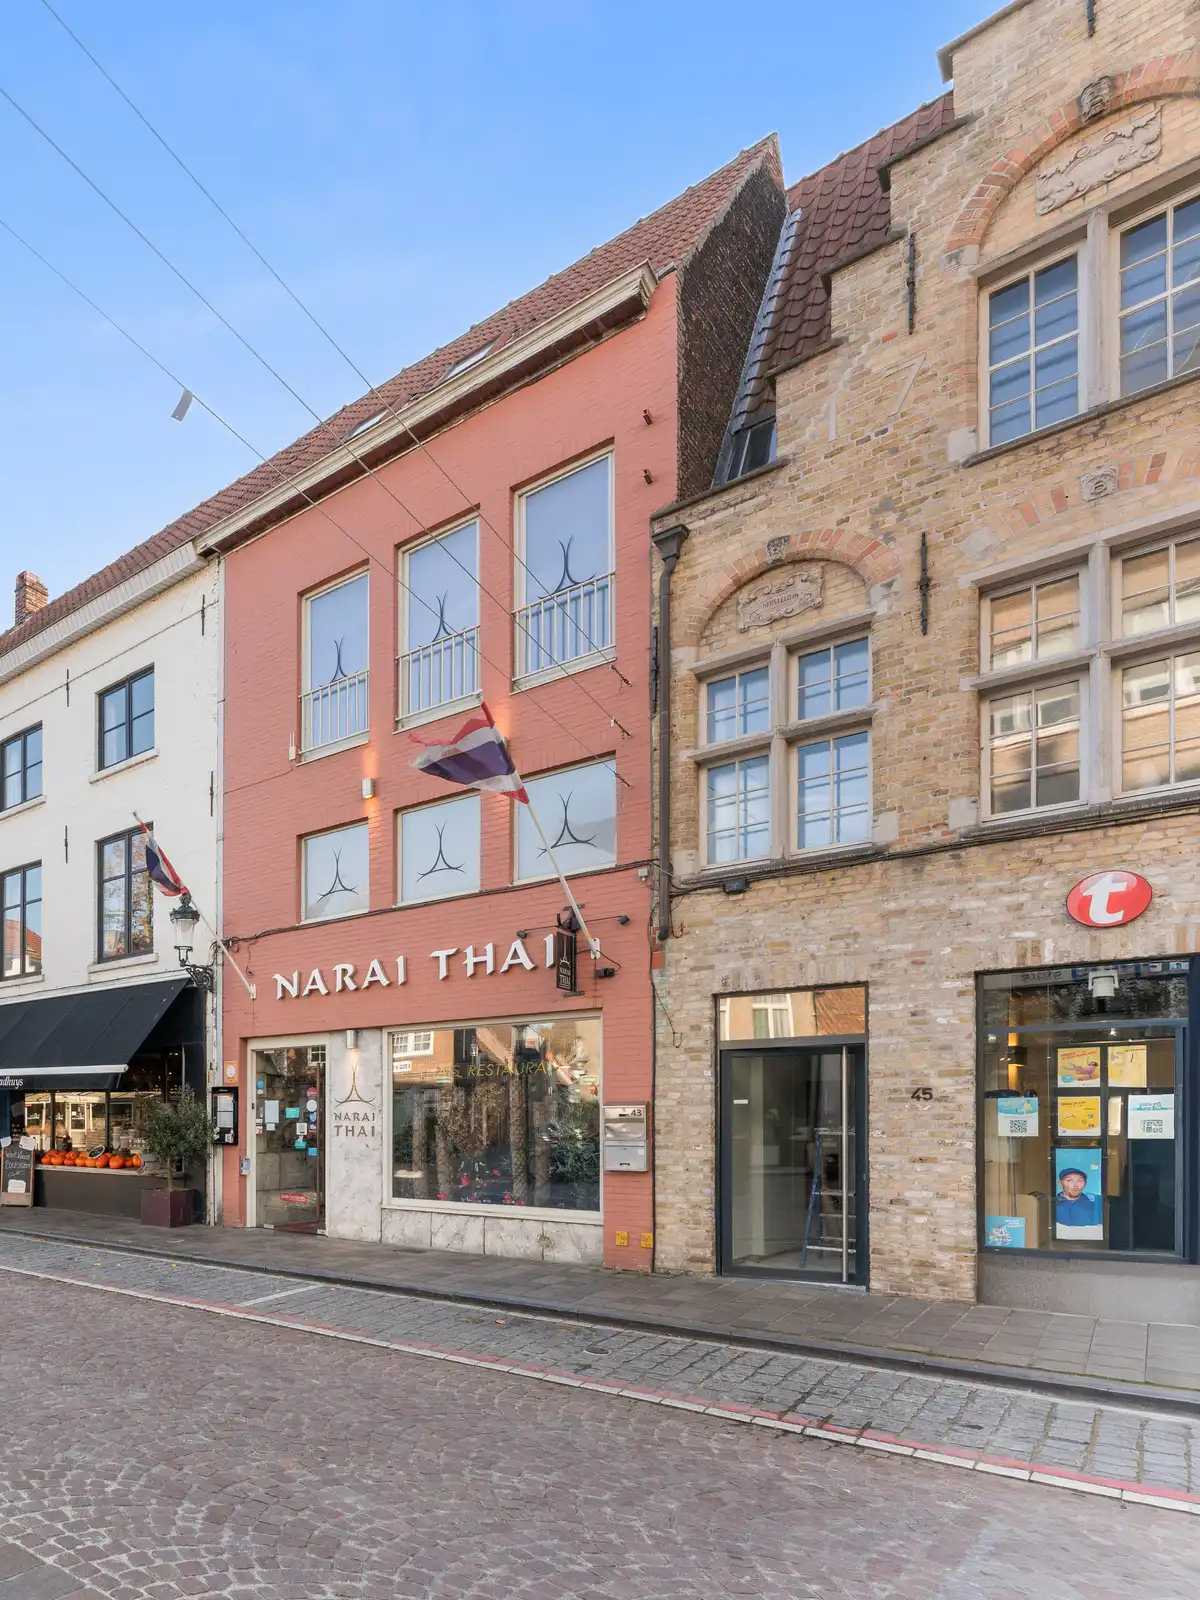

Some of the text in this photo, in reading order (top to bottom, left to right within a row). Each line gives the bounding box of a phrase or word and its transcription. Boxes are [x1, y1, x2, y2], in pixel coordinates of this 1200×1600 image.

[1082, 873, 1128, 925] t
[272, 932, 556, 1000] NARAI THAI
[559, 974, 571, 984] THAI
[910, 1087, 933, 1102] 45
[333, 1111, 376, 1122] NARAI
[630, 1109, 642, 1117] 43
[333, 1124, 376, 1138] THAI
